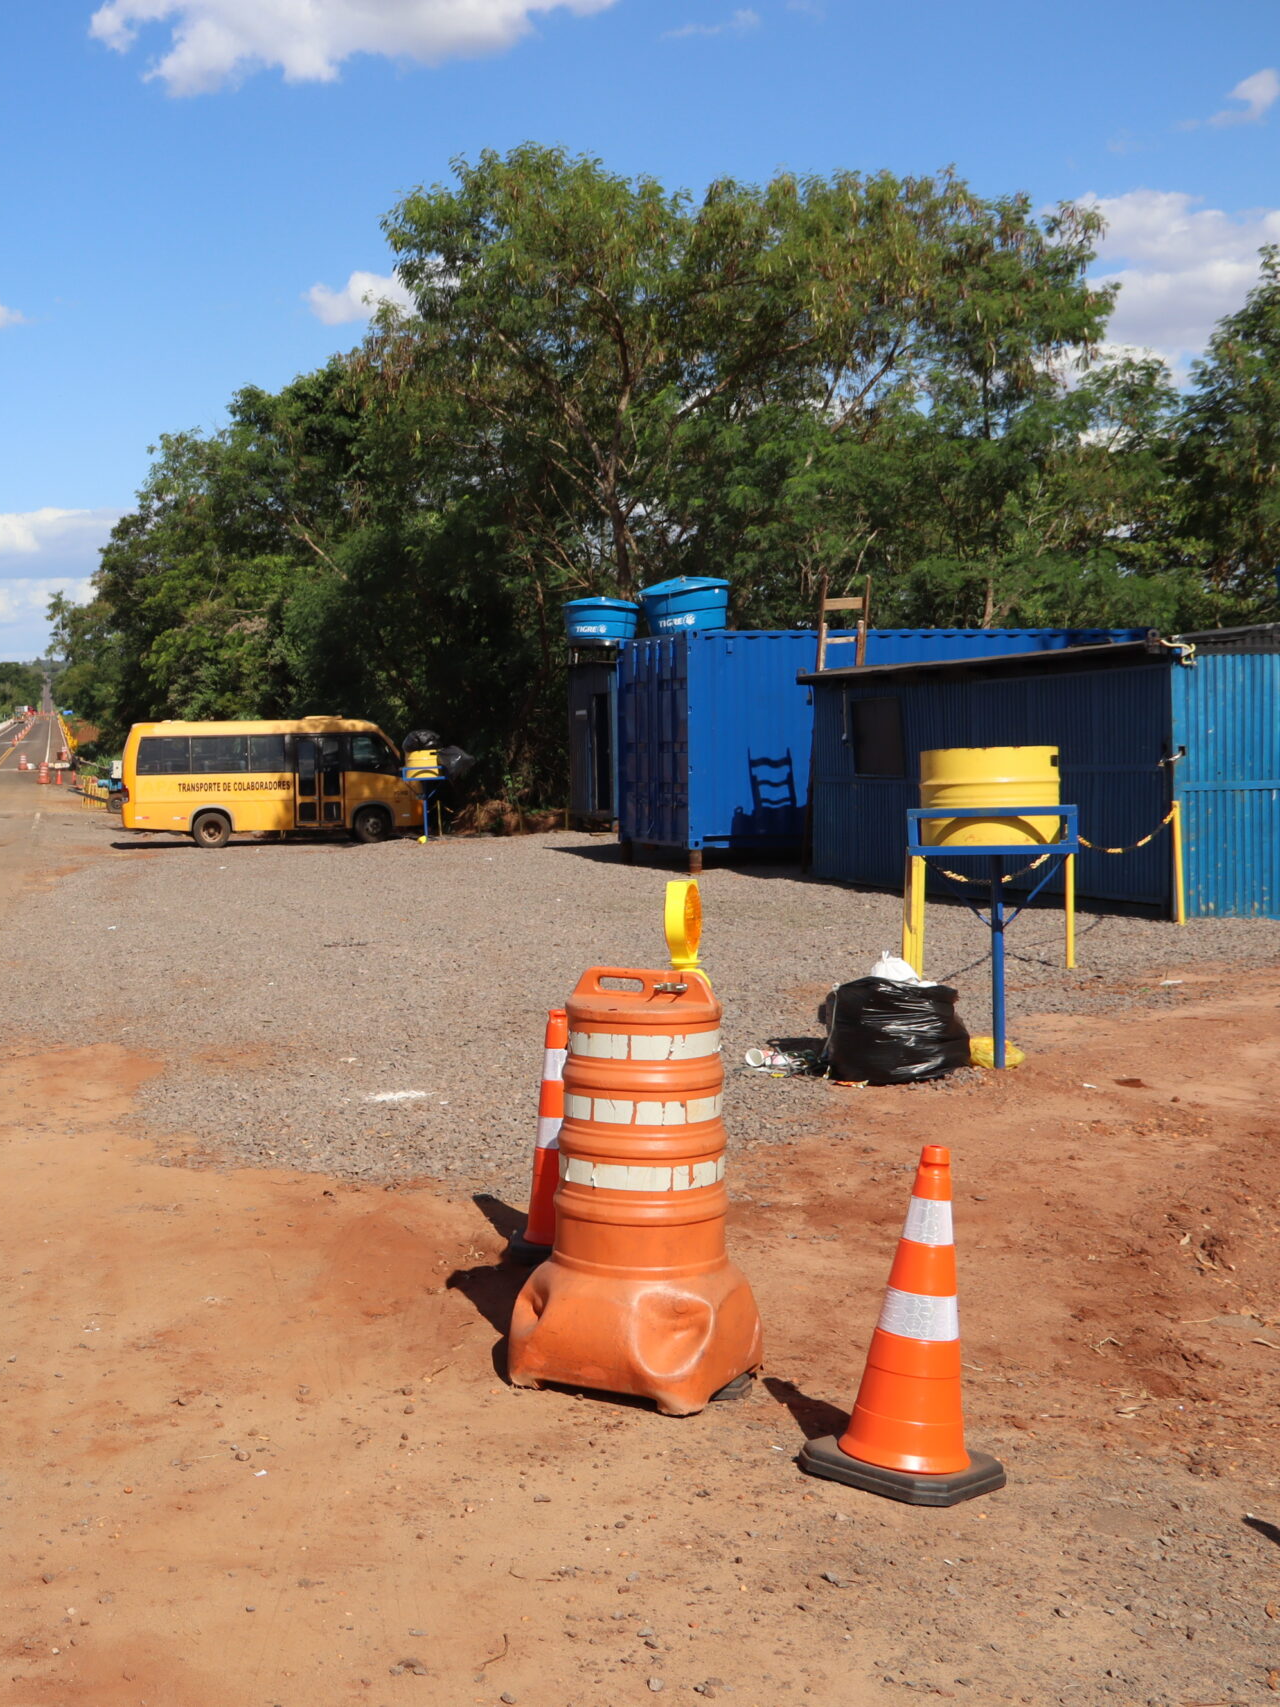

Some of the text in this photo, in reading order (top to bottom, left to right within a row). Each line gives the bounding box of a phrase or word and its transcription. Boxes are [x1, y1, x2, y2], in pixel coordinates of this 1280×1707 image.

[658, 617, 684, 628] TIGRE
[576, 625, 597, 633] TIGRE
[178, 782, 221, 792] TRANSPORTE
[223, 782, 231, 791] DE
[233, 780, 291, 791] COLABORADORES
